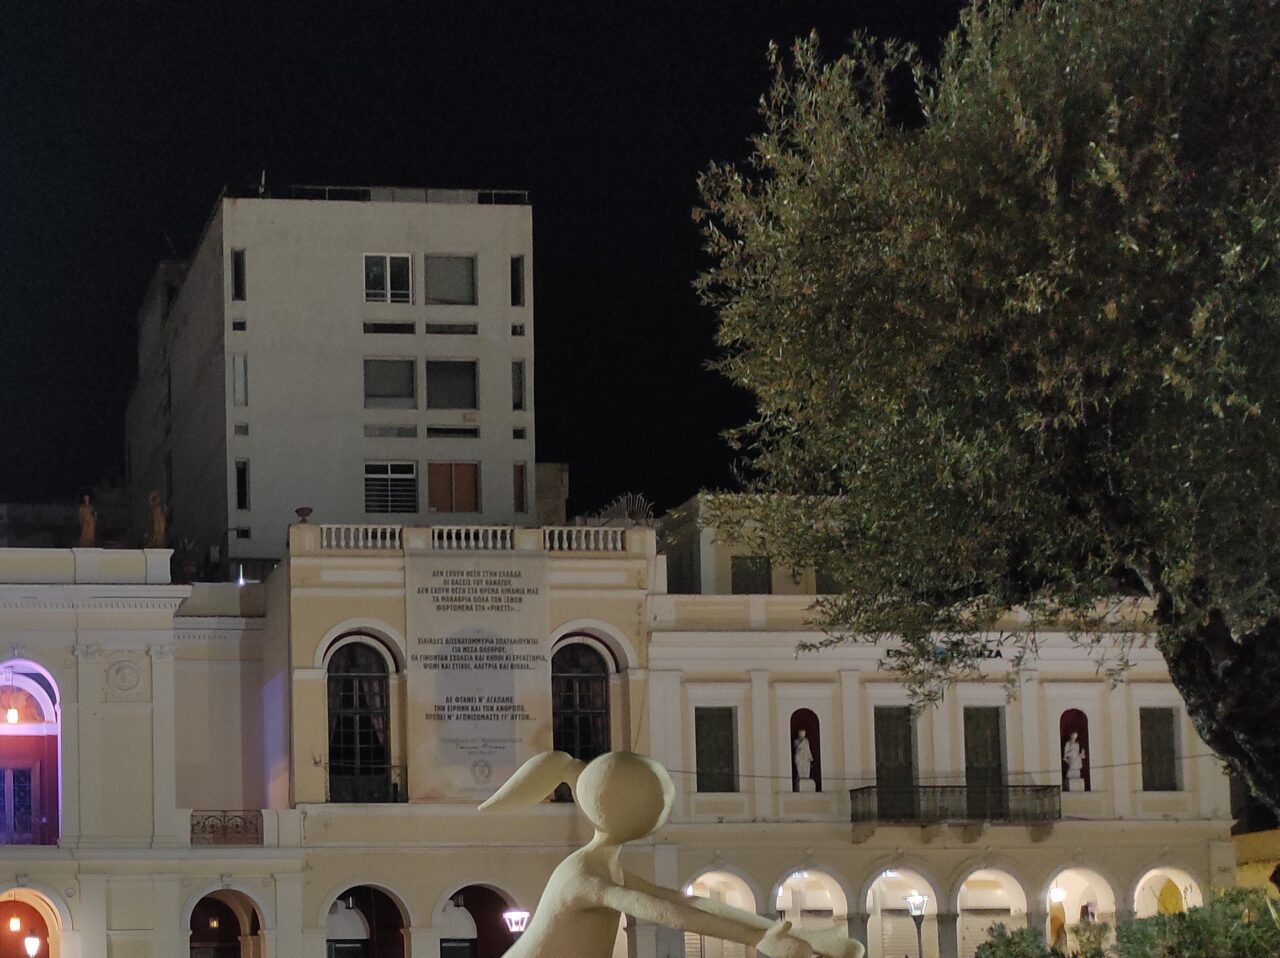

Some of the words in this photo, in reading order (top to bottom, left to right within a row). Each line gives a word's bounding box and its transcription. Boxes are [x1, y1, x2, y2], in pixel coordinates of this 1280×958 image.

[432, 570, 444, 578] ΔΕΝ
[445, 570, 465, 578] ΕΧΟΥΝ
[466, 570, 480, 578] ΘΕΣΗ
[482, 570, 498, 578] ΣΤΗΝ
[499, 570, 522, 578] ΕΛΛΑΔΑ
[417, 587, 429, 595] ΔΕΝ
[430, 587, 450, 595] ΕΧΟΥΝ
[451, 587, 466, 595] ΘΕΣΗ
[467, 587, 478, 595] ΣΤΑ
[479, 587, 499, 595] ΗΡΕΜΑ
[500, 587, 526, 595] ΛΙΜΑΝΙΑ
[527, 587, 539, 595] ΜΑΣ
[475, 604, 486, 612] ΣΤΑ
[423, 662, 440, 670] ΨΩΜΙ
[441, 662, 450, 670] ΚΑΙ
[474, 662, 498, 670] ΑΛΕΤΡΙΑ
[499, 662, 509, 670] ΚΑΙ
[434, 704, 446, 712] ΤΗΝ
[447, 704, 470, 712] ΕΙΡΗΝΗ
[471, 704, 482, 712] ΚΑΙ
[483, 704, 494, 712] ΤΟΝ
